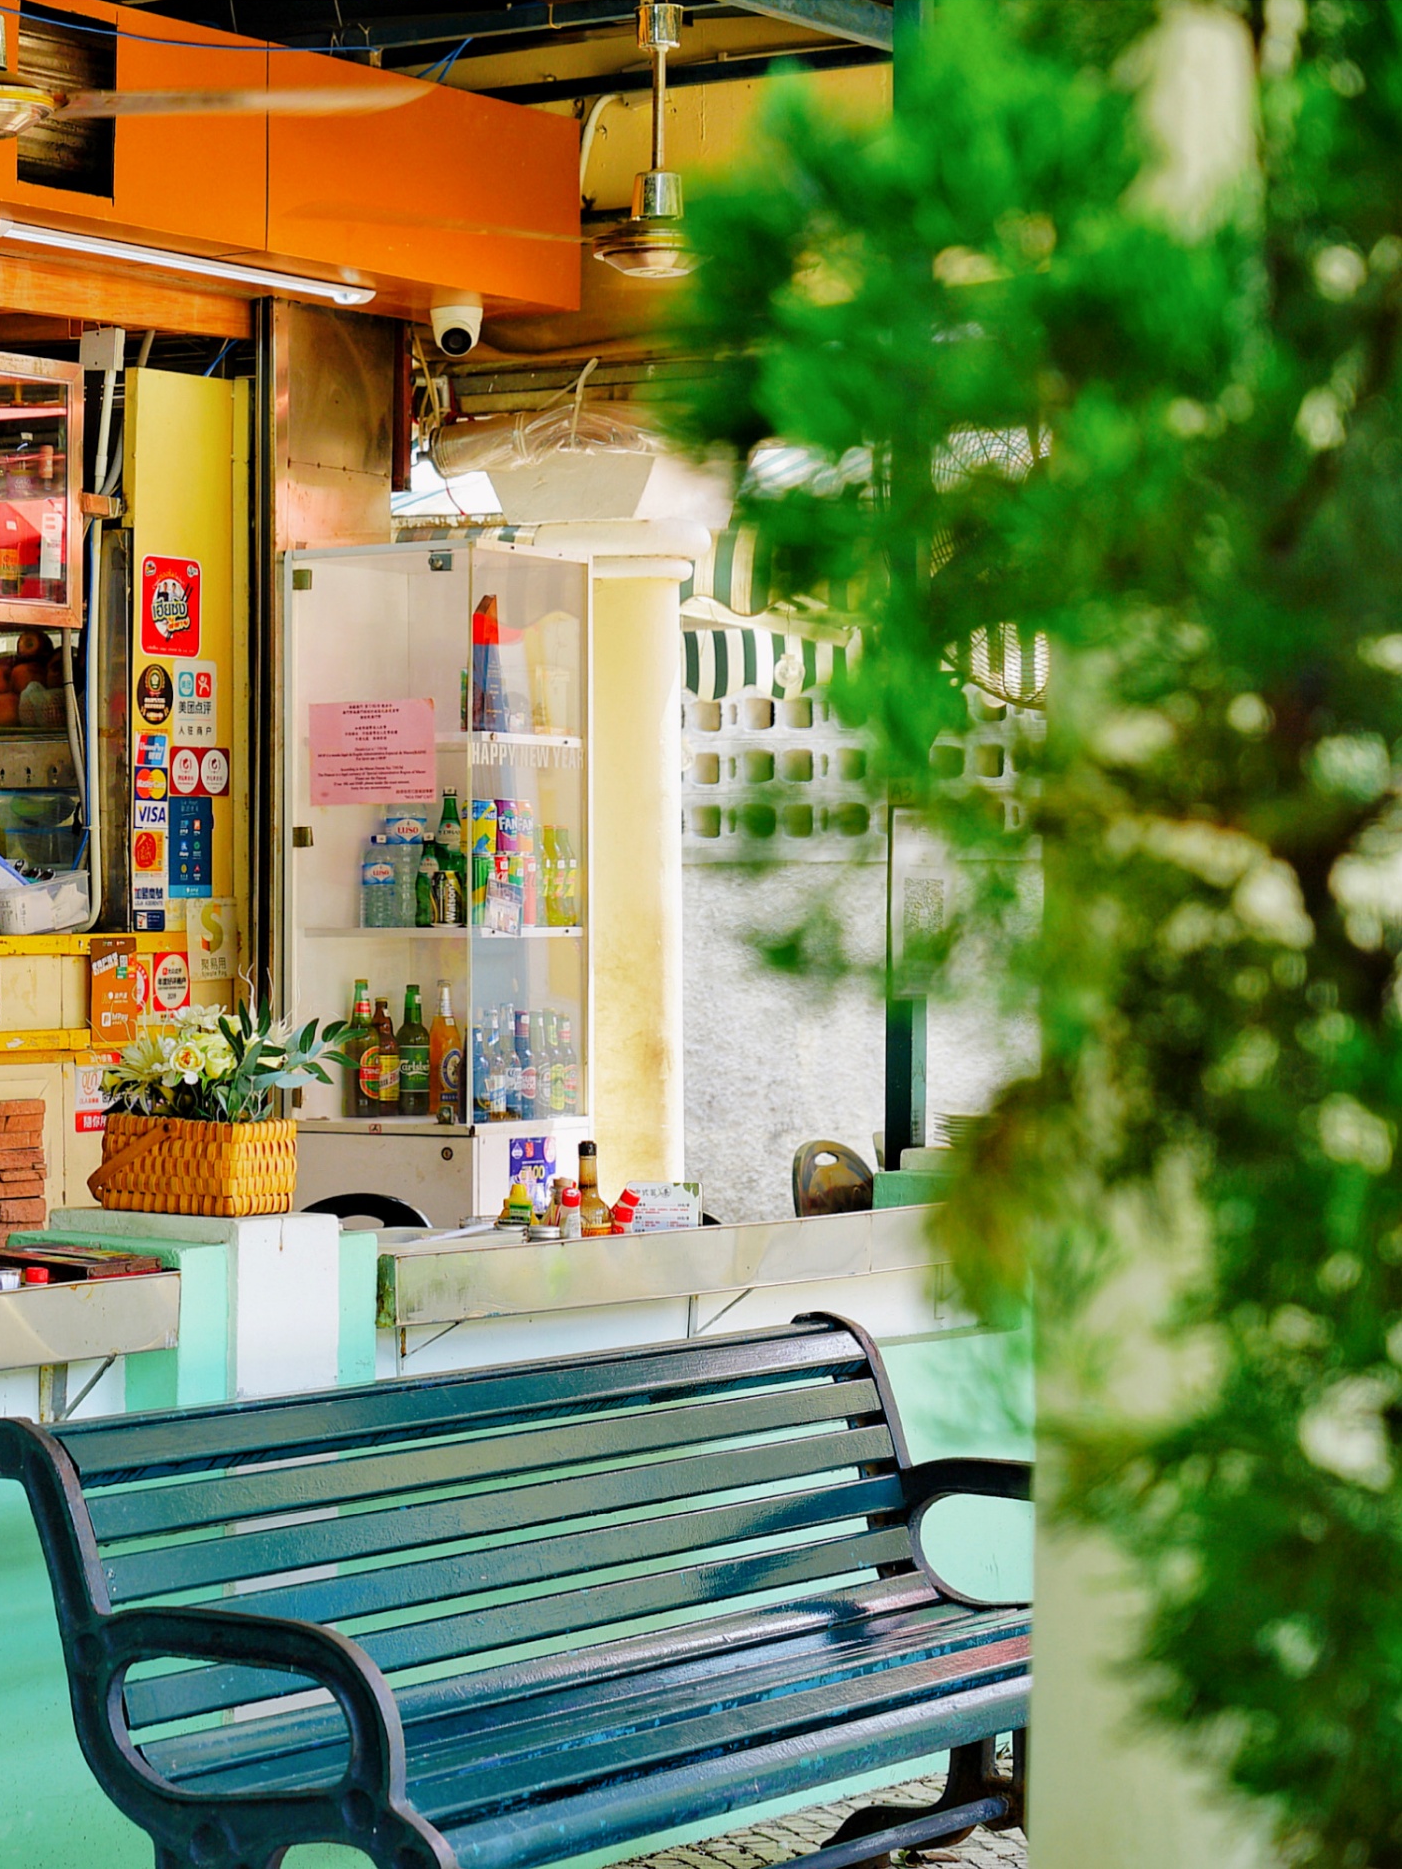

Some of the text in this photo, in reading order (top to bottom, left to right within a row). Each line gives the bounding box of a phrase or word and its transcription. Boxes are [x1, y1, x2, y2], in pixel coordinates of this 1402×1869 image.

[178, 701, 211, 715] 美团点评
[472, 742, 583, 769] HAPPY NEW YEAR
[138, 806, 166, 823] VISA
[397, 825, 418, 834] LUSO
[372, 869, 389, 877] LUSO
[400, 1059, 430, 1074] Carlsber
